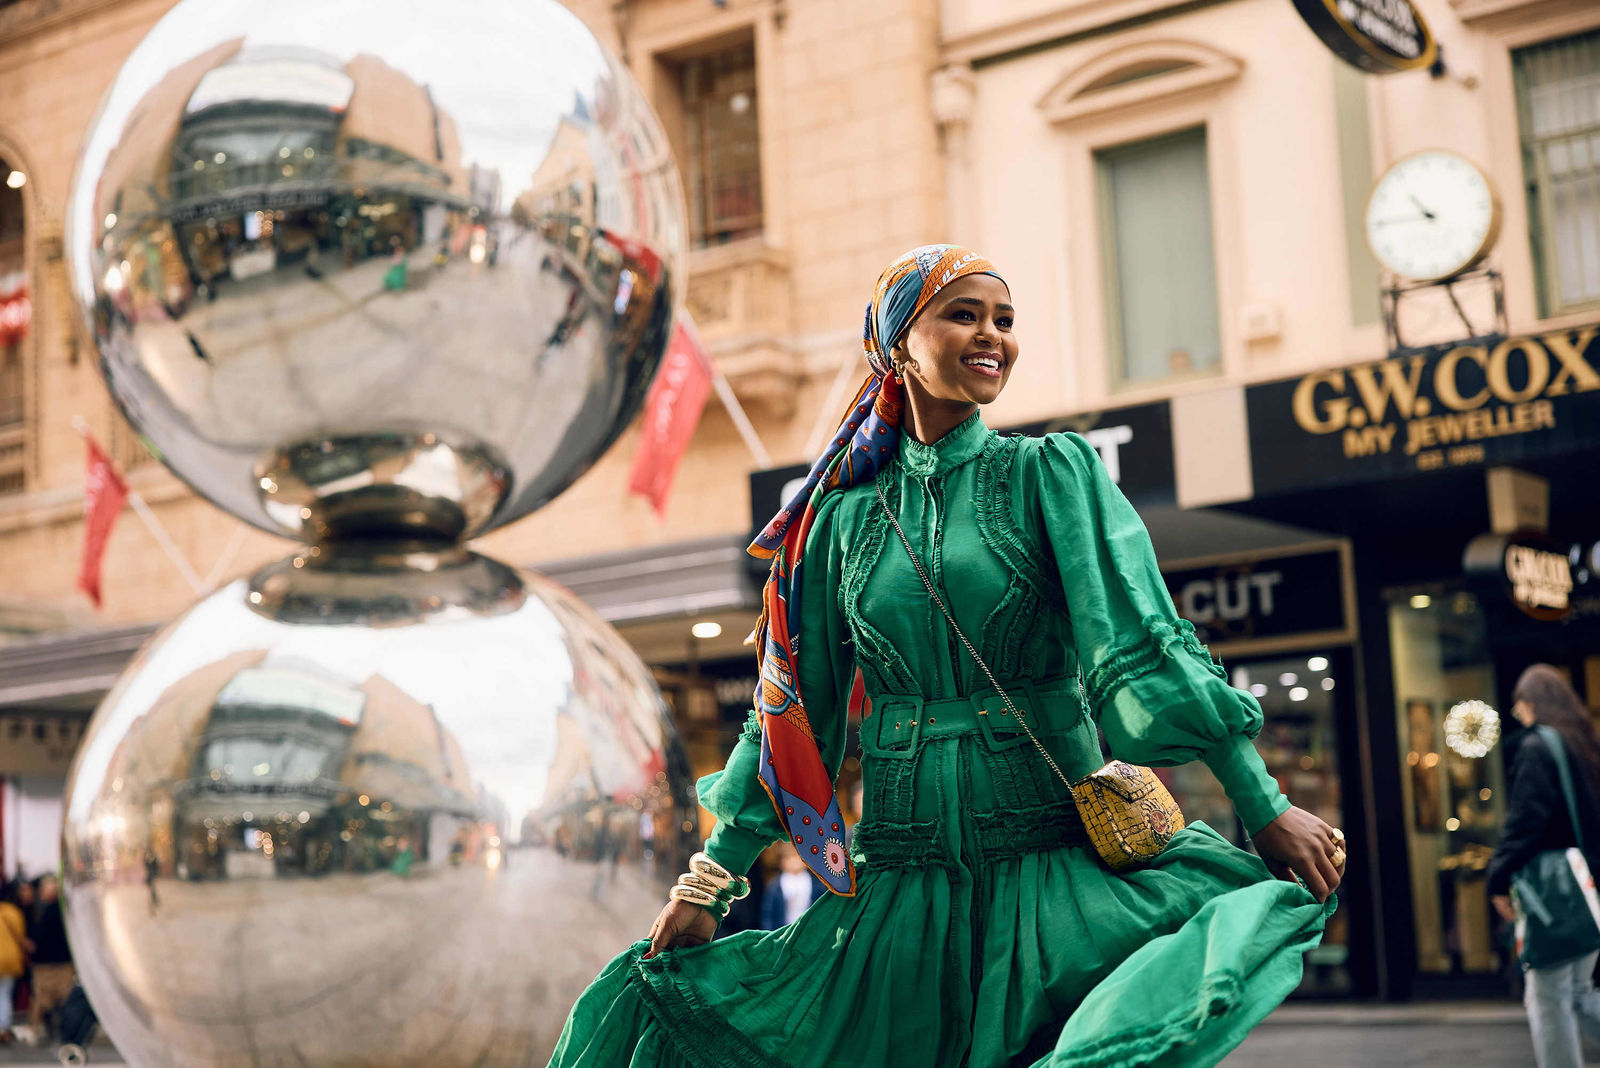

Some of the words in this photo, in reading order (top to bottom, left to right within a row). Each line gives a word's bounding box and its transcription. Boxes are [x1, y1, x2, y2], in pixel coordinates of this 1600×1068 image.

[1433, 329, 1600, 411] COX
[1342, 423, 1397, 458] MY
[1404, 400, 1555, 456] JEWELLER
[1182, 571, 1282, 623] CUT
